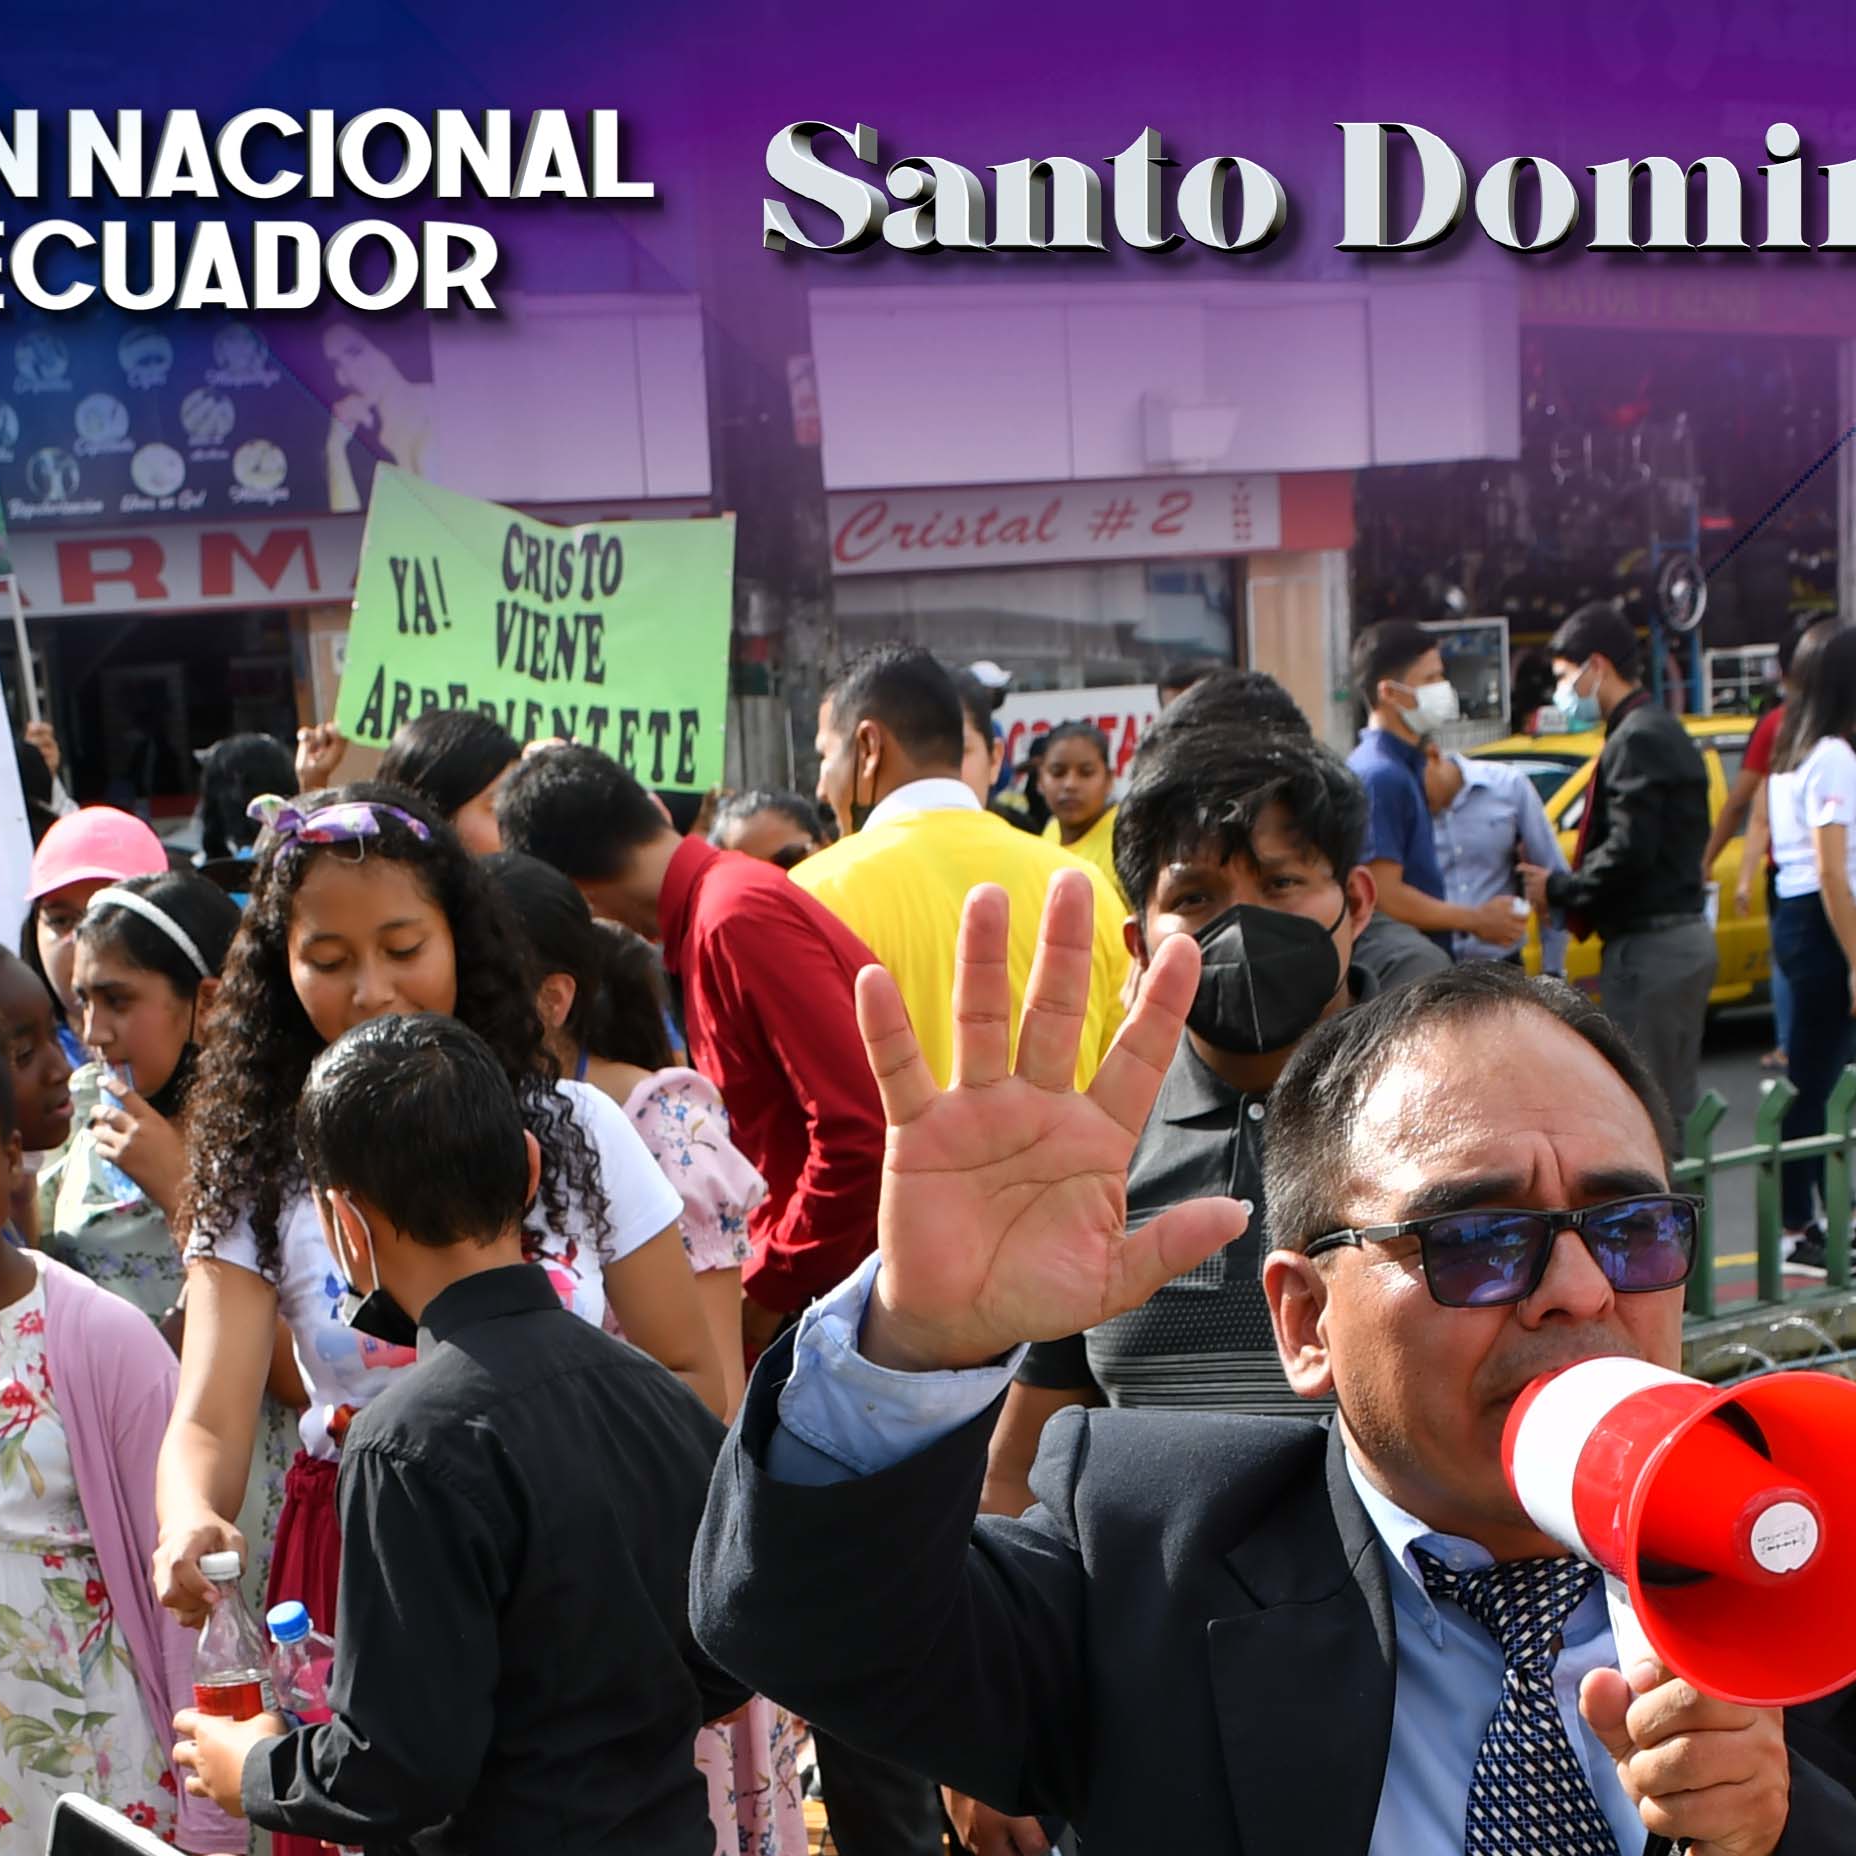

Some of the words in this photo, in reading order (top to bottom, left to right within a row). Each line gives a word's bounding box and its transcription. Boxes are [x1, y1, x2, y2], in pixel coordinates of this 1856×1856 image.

[502, 522, 624, 603] CRISTO
[833, 497, 1058, 563] Cristal
[388, 556, 453, 636] YA!
[497, 600, 607, 686] VIENE
